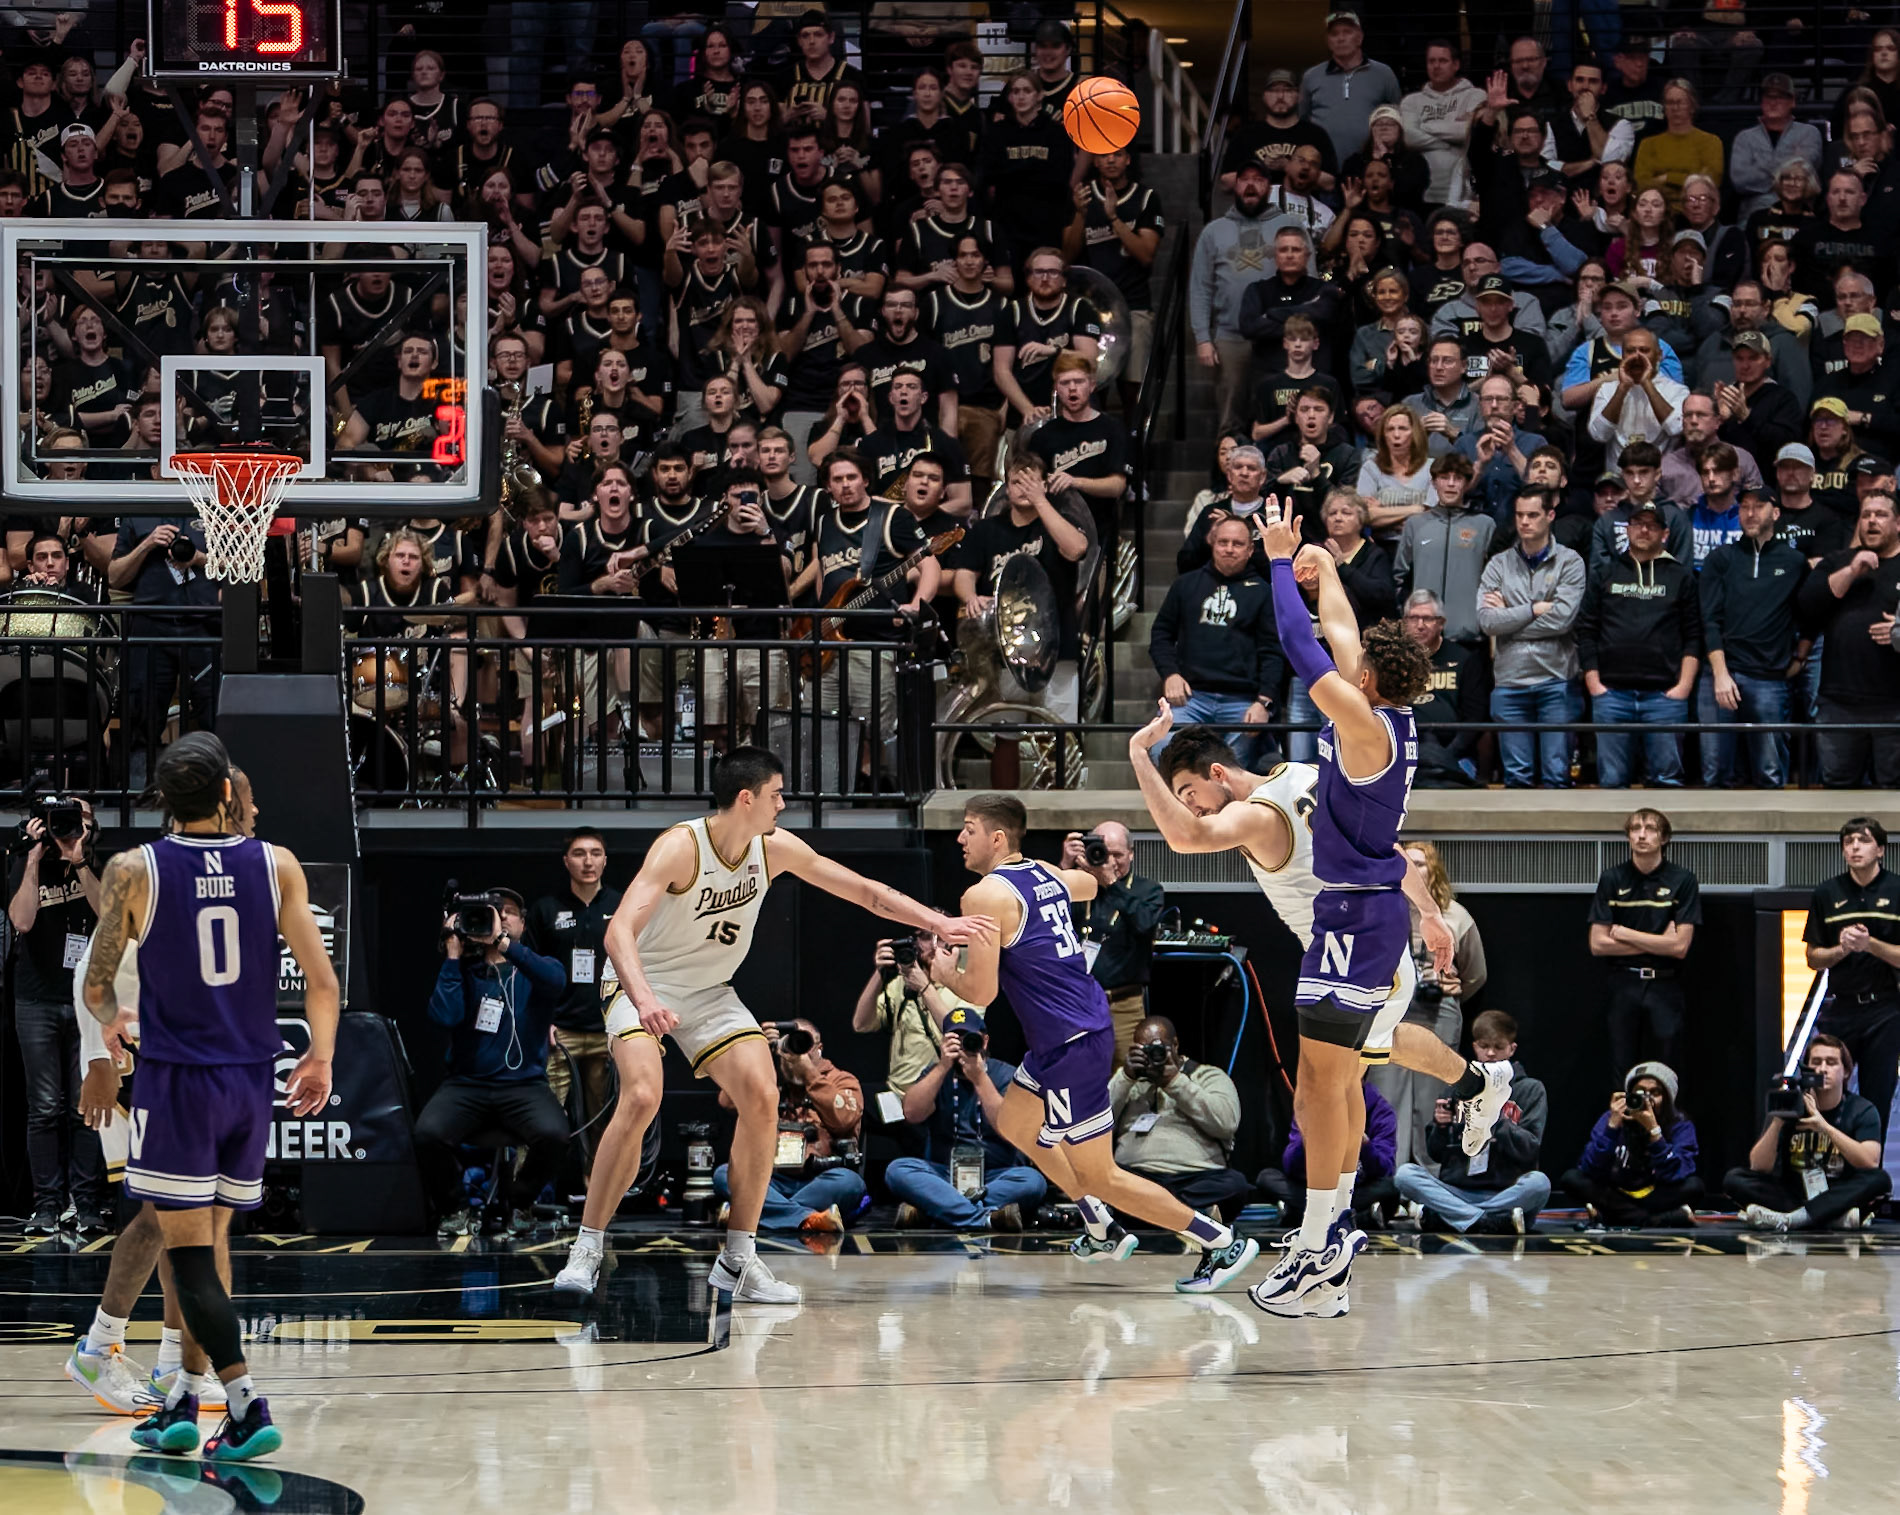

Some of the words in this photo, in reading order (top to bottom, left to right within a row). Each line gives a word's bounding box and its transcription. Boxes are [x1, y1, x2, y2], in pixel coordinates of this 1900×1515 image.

[225, 0, 303, 53] 15
[199, 62, 292, 71] DAKTRONICS
[1815, 242, 1876, 257] PURDUE
[205, 851, 224, 875] N
[195, 876, 237, 899] BUIE
[694, 876, 758, 912] Purdue
[196, 905, 242, 987] 0
[706, 920, 742, 946] 15
[1320, 931, 1355, 978] N
[1047, 1088, 1073, 1126] N
